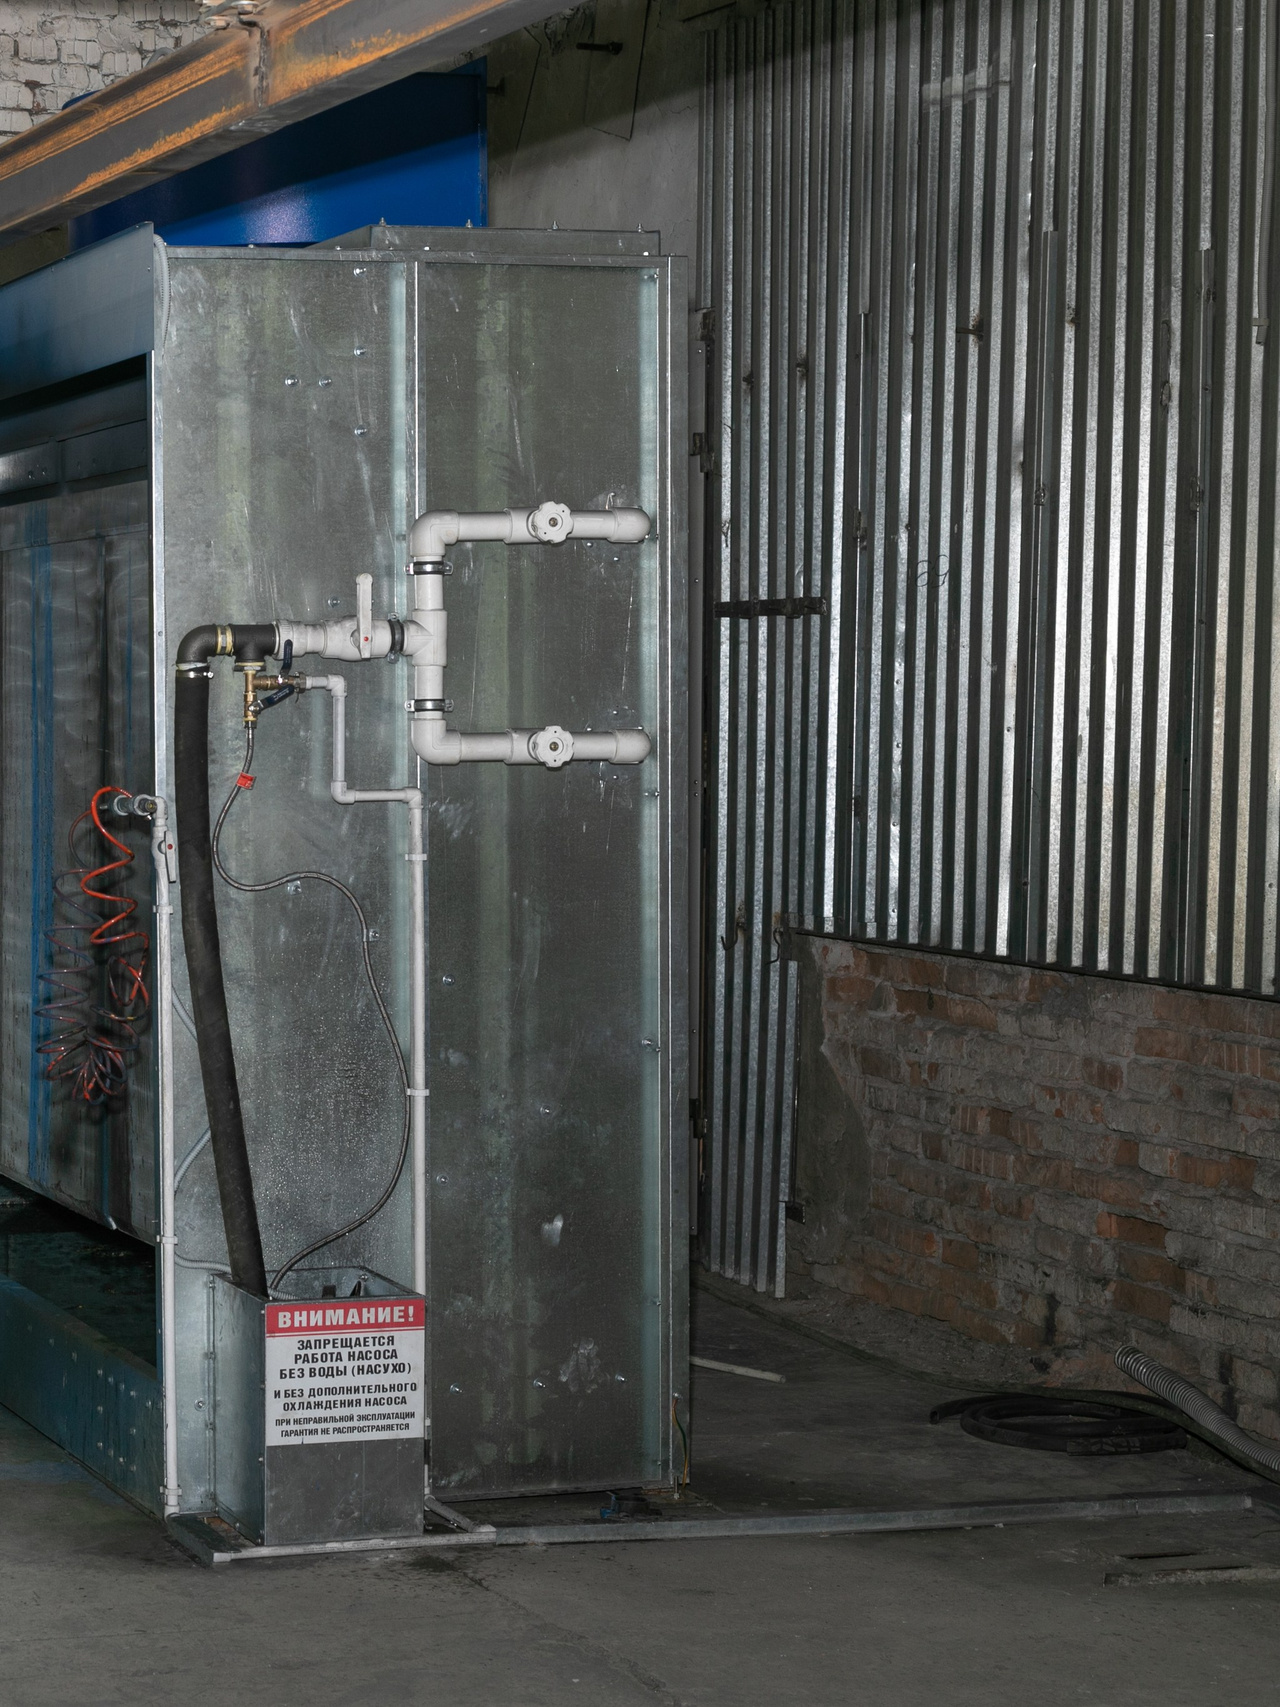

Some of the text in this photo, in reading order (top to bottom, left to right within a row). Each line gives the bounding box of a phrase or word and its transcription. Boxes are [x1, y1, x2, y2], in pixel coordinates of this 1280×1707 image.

[278, 1306, 414, 1328] ВНИМАНИЕ!
[297, 1335, 395, 1351] ЗАПРЕЩАЕТСЯ
[294, 1349, 398, 1365] РАБОТА НАСОСА
[279, 1362, 412, 1380] БЕЗ ВОДЫ (НАСУХО)
[273, 1382, 417, 1399] И БЕЗ ДОПОЛНИТЕЛЬНОГО
[282, 1395, 407, 1412] ОХЛАЖДЕНИЯ НАСОСА
[275, 1411, 415, 1427] ПРИ НЕПРАВИЛЬНОЙ ЭКСПЛУАТАЦИИ
[281, 1423, 410, 1438] ГАРАНТИЯ НЕ РАСПРОСТРАНЯЕТСЯ
